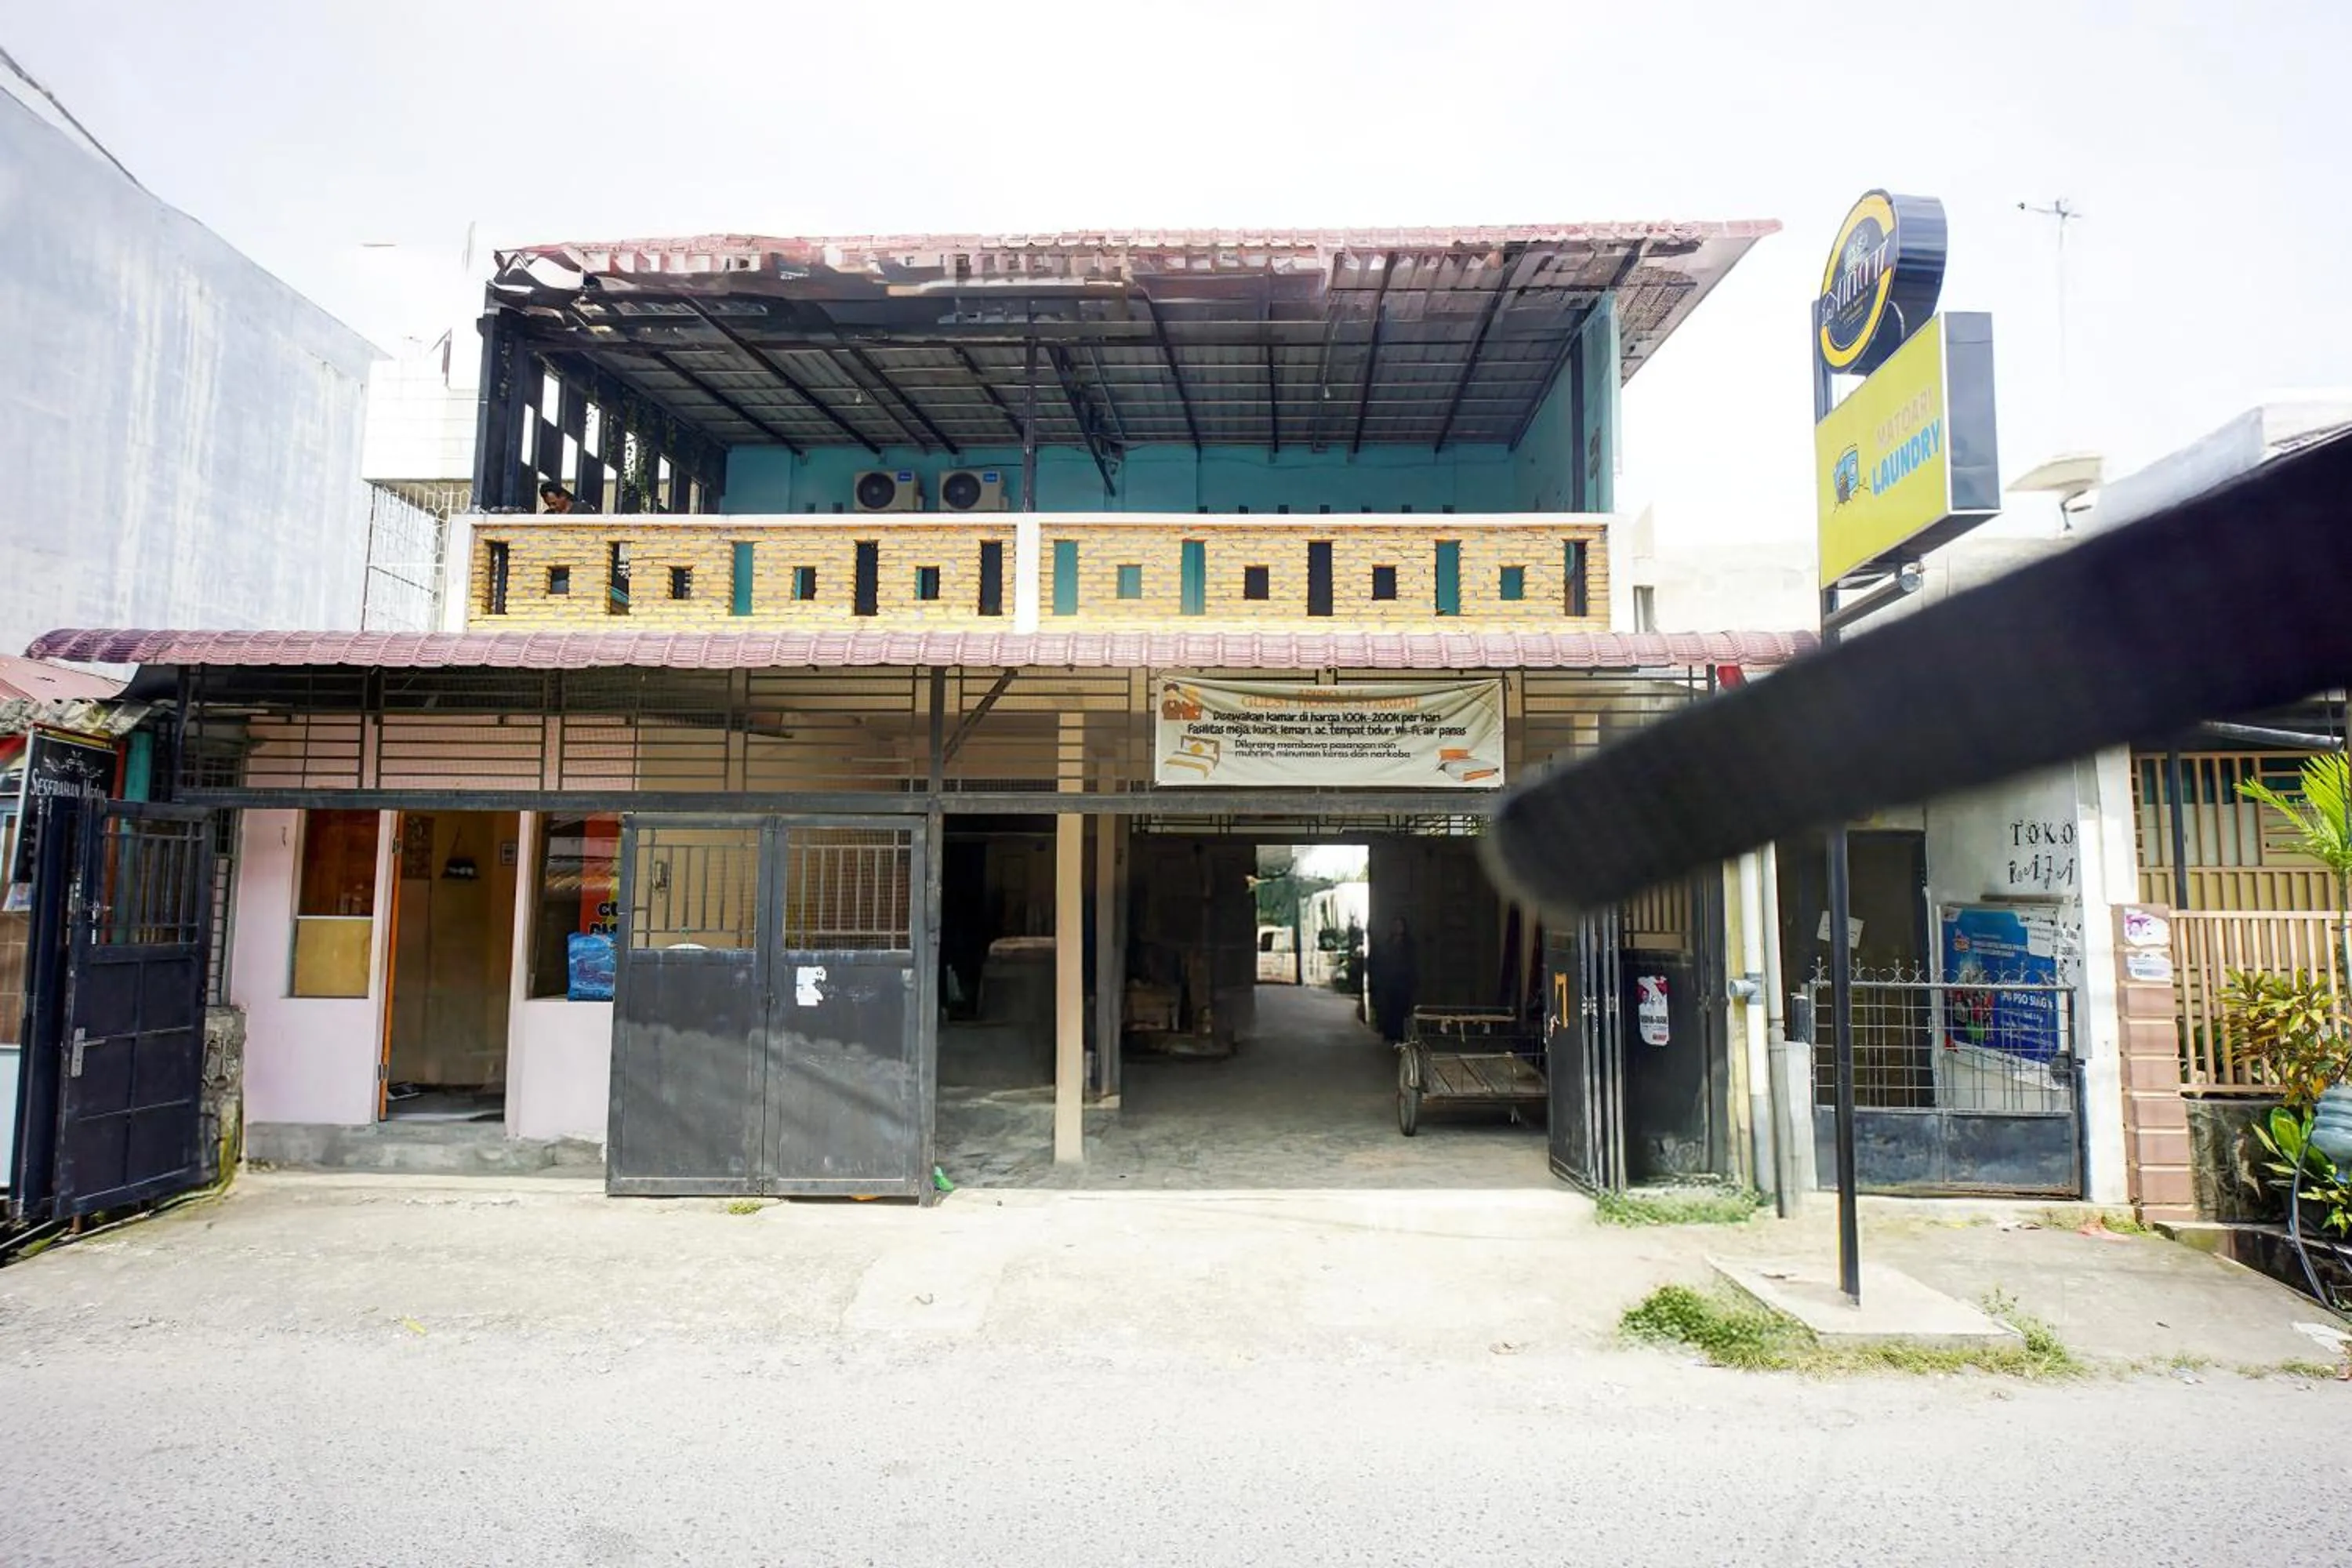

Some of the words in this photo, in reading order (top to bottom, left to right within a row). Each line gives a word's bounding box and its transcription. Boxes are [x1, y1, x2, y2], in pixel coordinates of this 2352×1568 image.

[1871, 418, 1940, 495] LAUNDRY
[1213, 711, 1264, 721] Disewakan
[1299, 712, 1308, 722] di
[1311, 712, 1340, 724] harga
[1402, 714, 1421, 725] per
[1188, 723, 1225, 735] Fasilitas
[1330, 724, 1365, 738] tempat
[1424, 726, 1437, 736] air
[1439, 726, 1467, 739] panas
[1235, 739, 1276, 750] Dilarang
[1277, 740, 1327, 750] membawa
[1330, 742, 1376, 751] pasangan
[2009, 820, 2074, 847] TOKO
